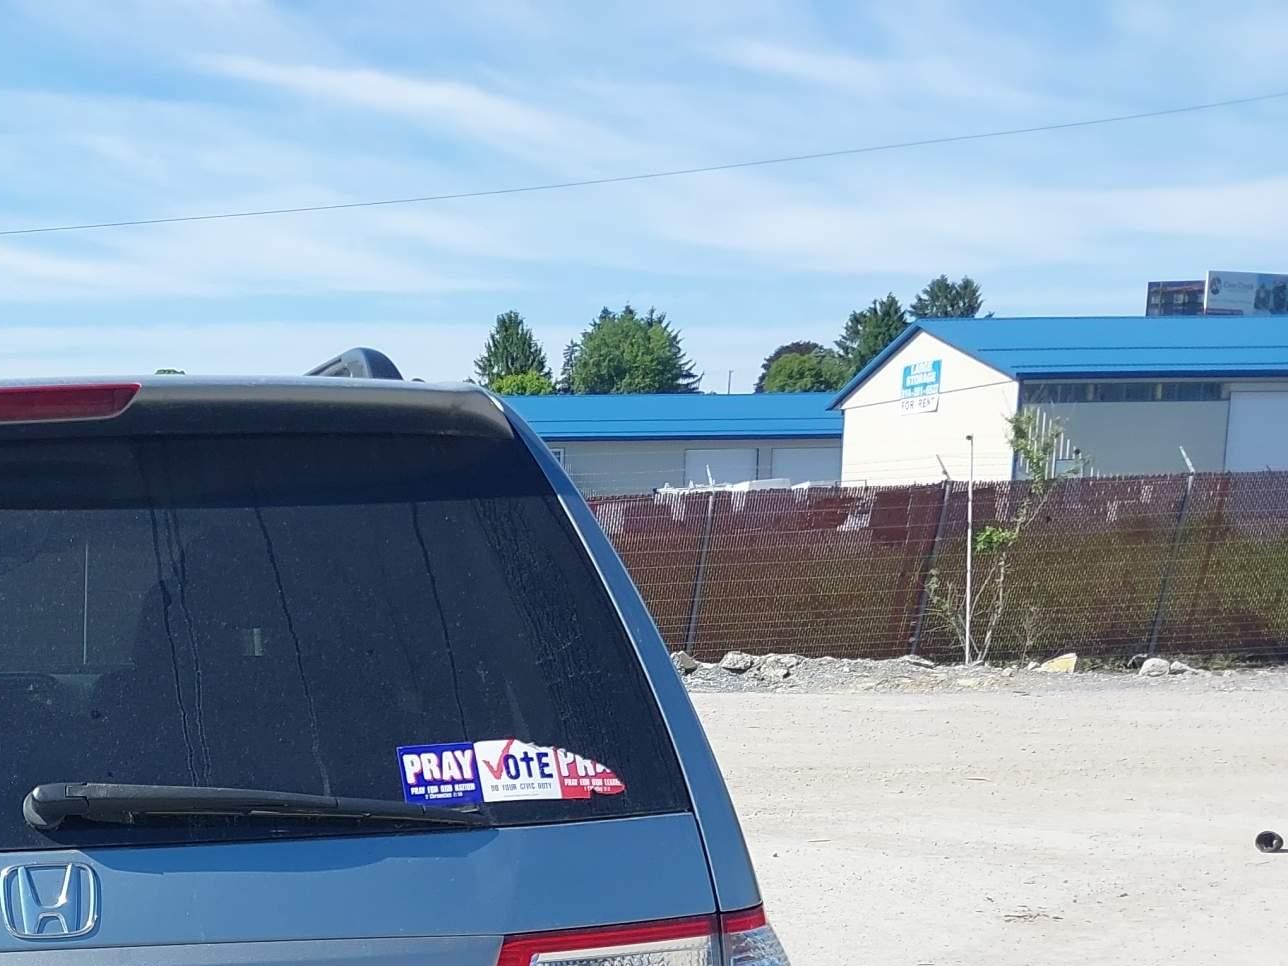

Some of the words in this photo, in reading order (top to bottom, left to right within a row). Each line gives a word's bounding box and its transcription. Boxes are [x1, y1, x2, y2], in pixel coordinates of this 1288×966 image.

[901, 400, 914, 410] FOR
[918, 397, 936, 408] RENT
[402, 749, 474, 784] PRAY
